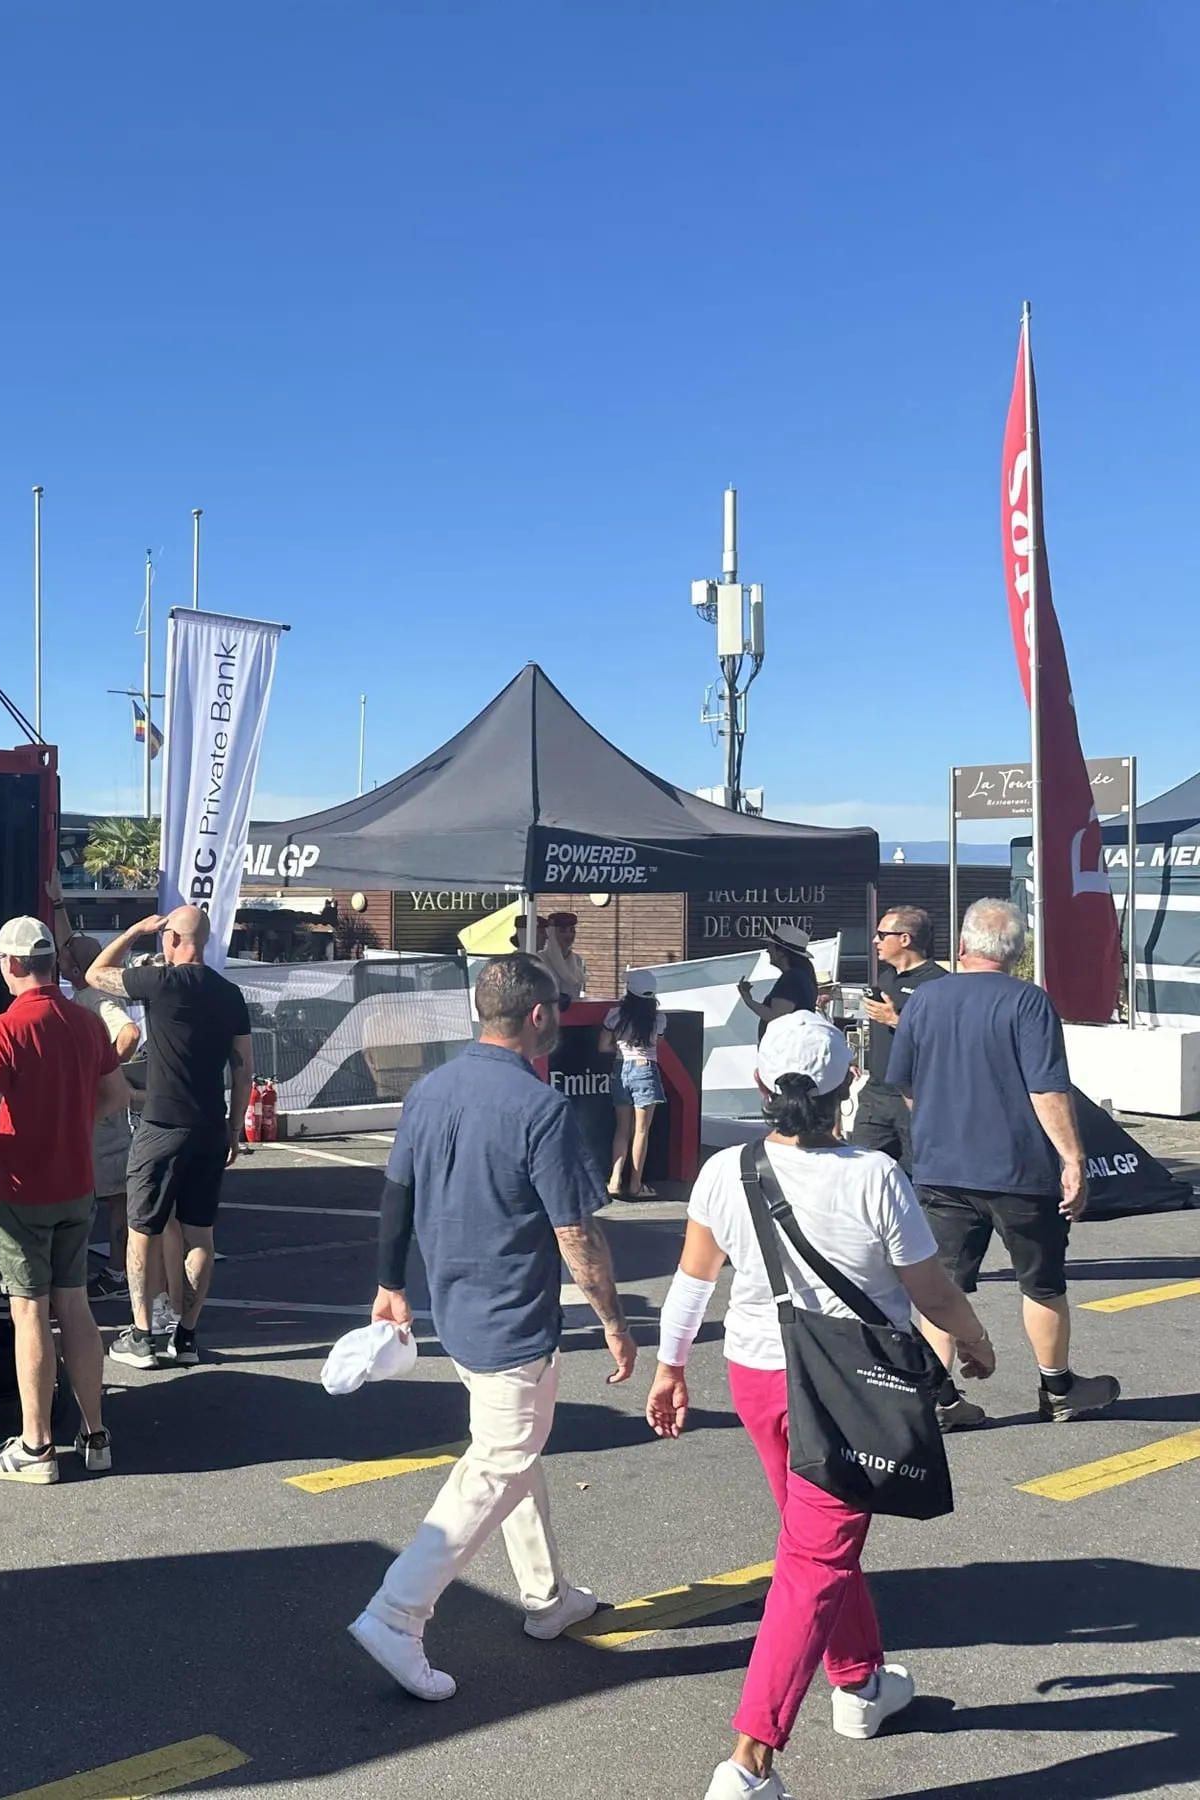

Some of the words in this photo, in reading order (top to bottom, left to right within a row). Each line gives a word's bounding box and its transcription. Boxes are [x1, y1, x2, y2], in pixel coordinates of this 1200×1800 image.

[210, 641, 238, 722] Bank
[198, 731, 229, 836] Private
[968, 771, 995, 798] La
[242, 843, 321, 878] AILGP
[545, 843, 637, 864] POWERED
[544, 864, 571, 882] BY
[410, 891, 477, 911] YACHT
[775, 884, 826, 904] CLUB
[703, 915, 731, 938] DE
[840, 1447, 897, 1474] INSIDE
[900, 1463, 927, 1482] OUT
